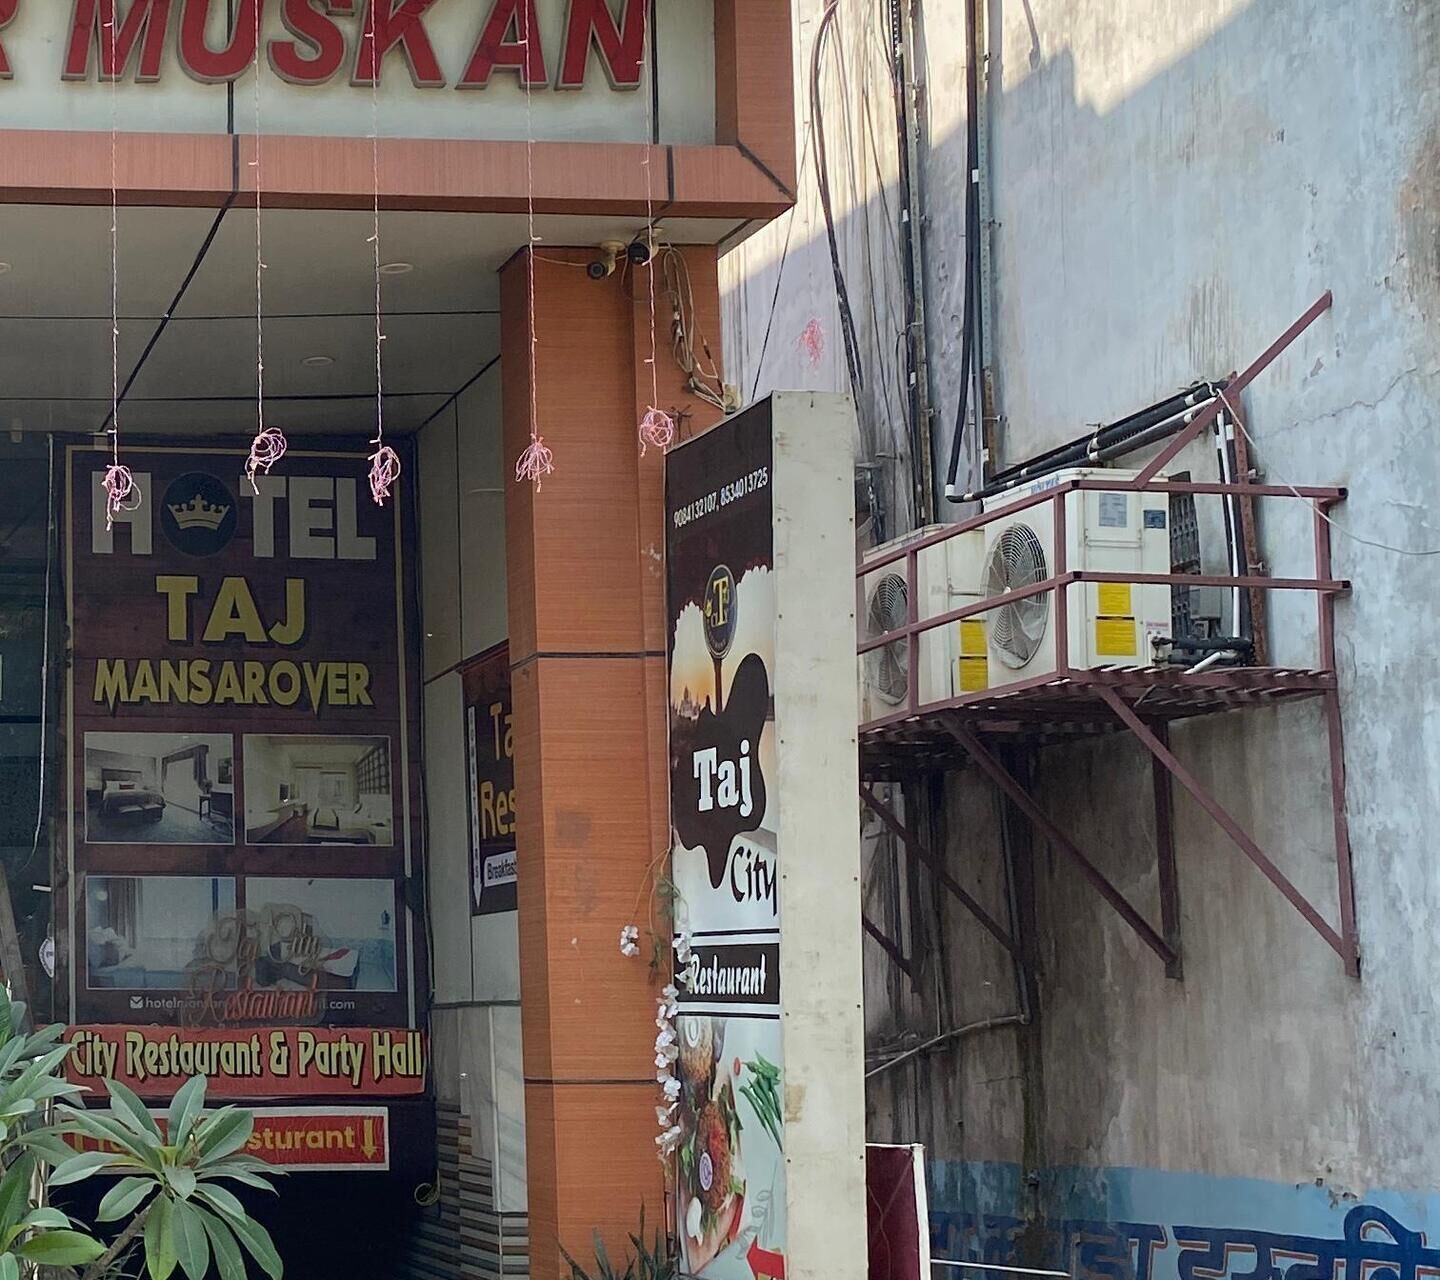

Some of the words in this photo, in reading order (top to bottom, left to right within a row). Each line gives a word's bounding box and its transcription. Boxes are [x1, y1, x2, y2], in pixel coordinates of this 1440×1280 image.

[155, 575, 306, 645] TAJ
[93, 658, 374, 715] MANSAROVER
[693, 739, 754, 817] Taj
[730, 845, 777, 916] City
[67, 1031, 117, 1078] City
[125, 1031, 262, 1081] Restaurant
[269, 1031, 291, 1076] &
[297, 1032, 364, 1087] Party
[371, 1031, 423, 1081] Hall
